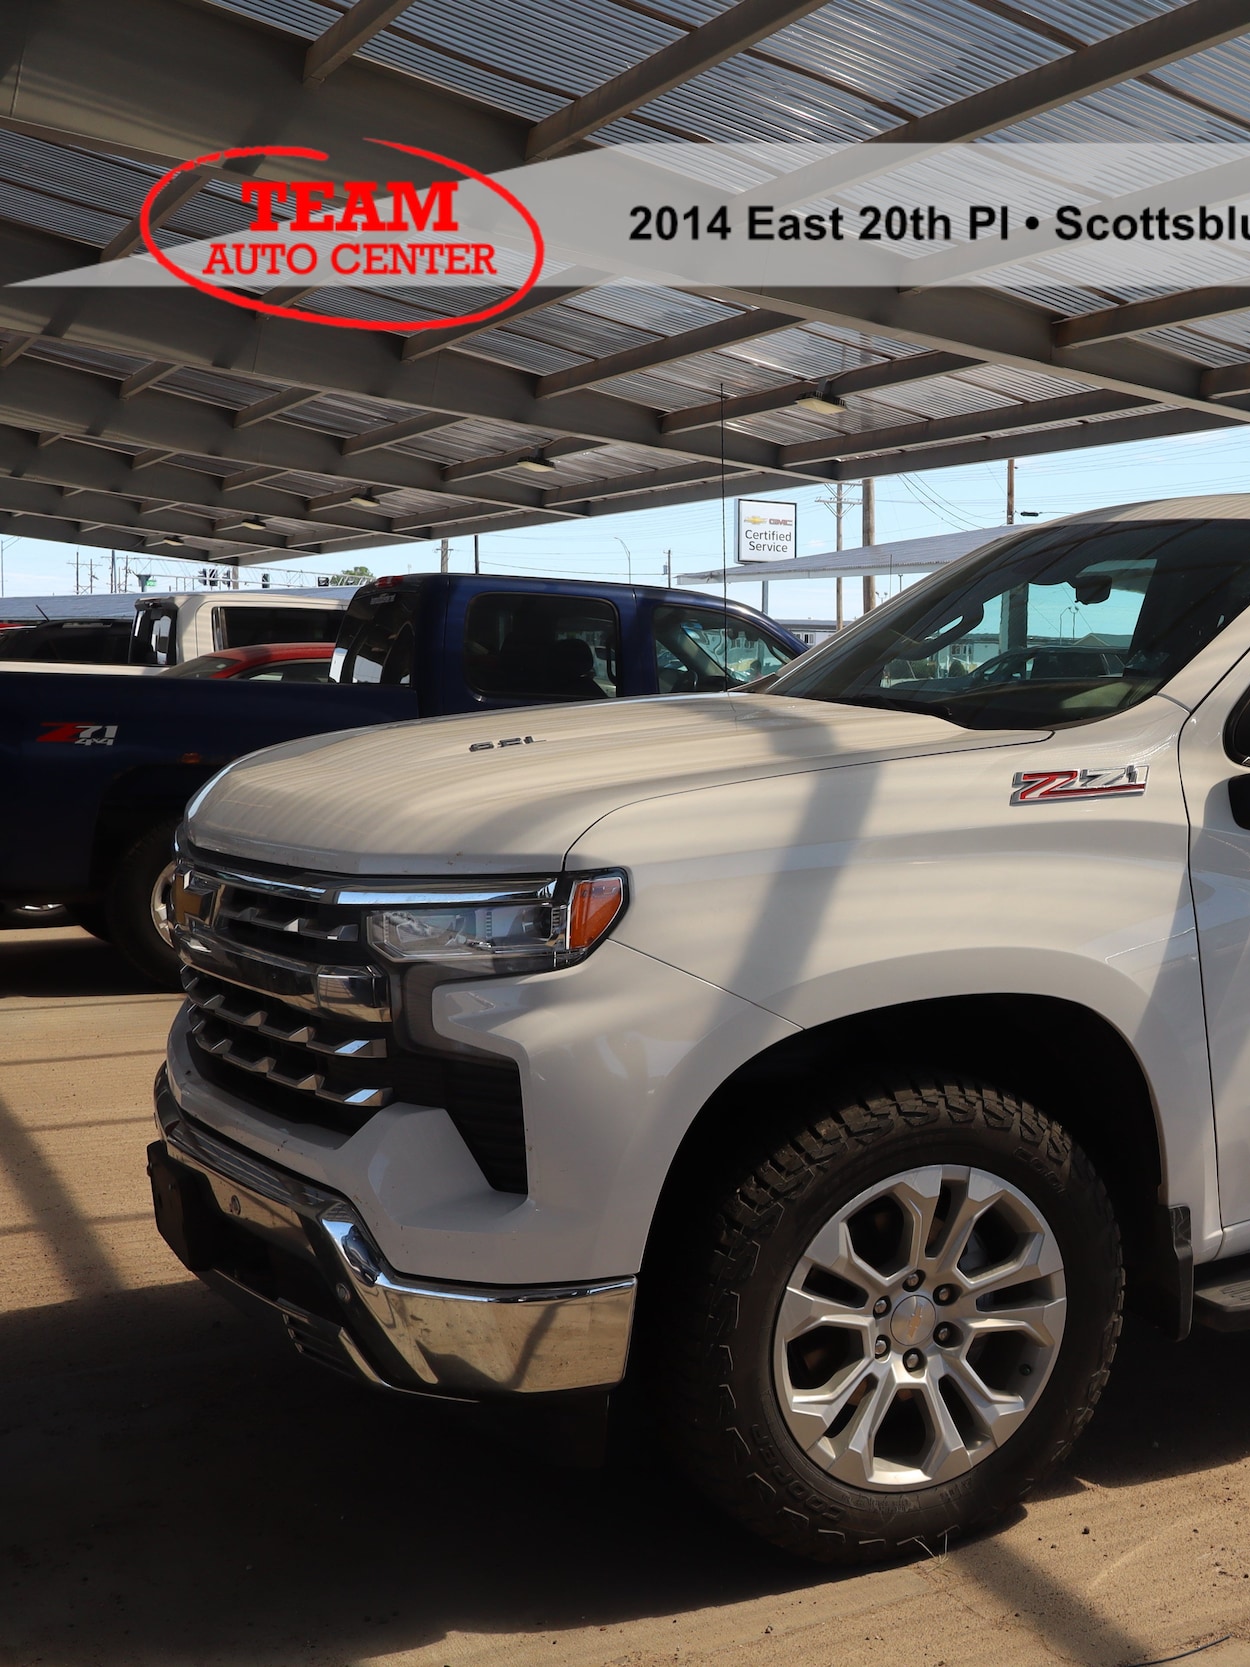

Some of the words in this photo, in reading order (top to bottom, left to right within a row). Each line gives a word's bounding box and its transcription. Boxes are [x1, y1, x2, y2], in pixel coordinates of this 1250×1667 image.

[769, 518, 793, 526] GMC
[745, 529, 792, 542] Certified
[748, 540, 788, 553] Service
[36, 721, 118, 743] Z71
[1009, 764, 1150, 806] Z71
